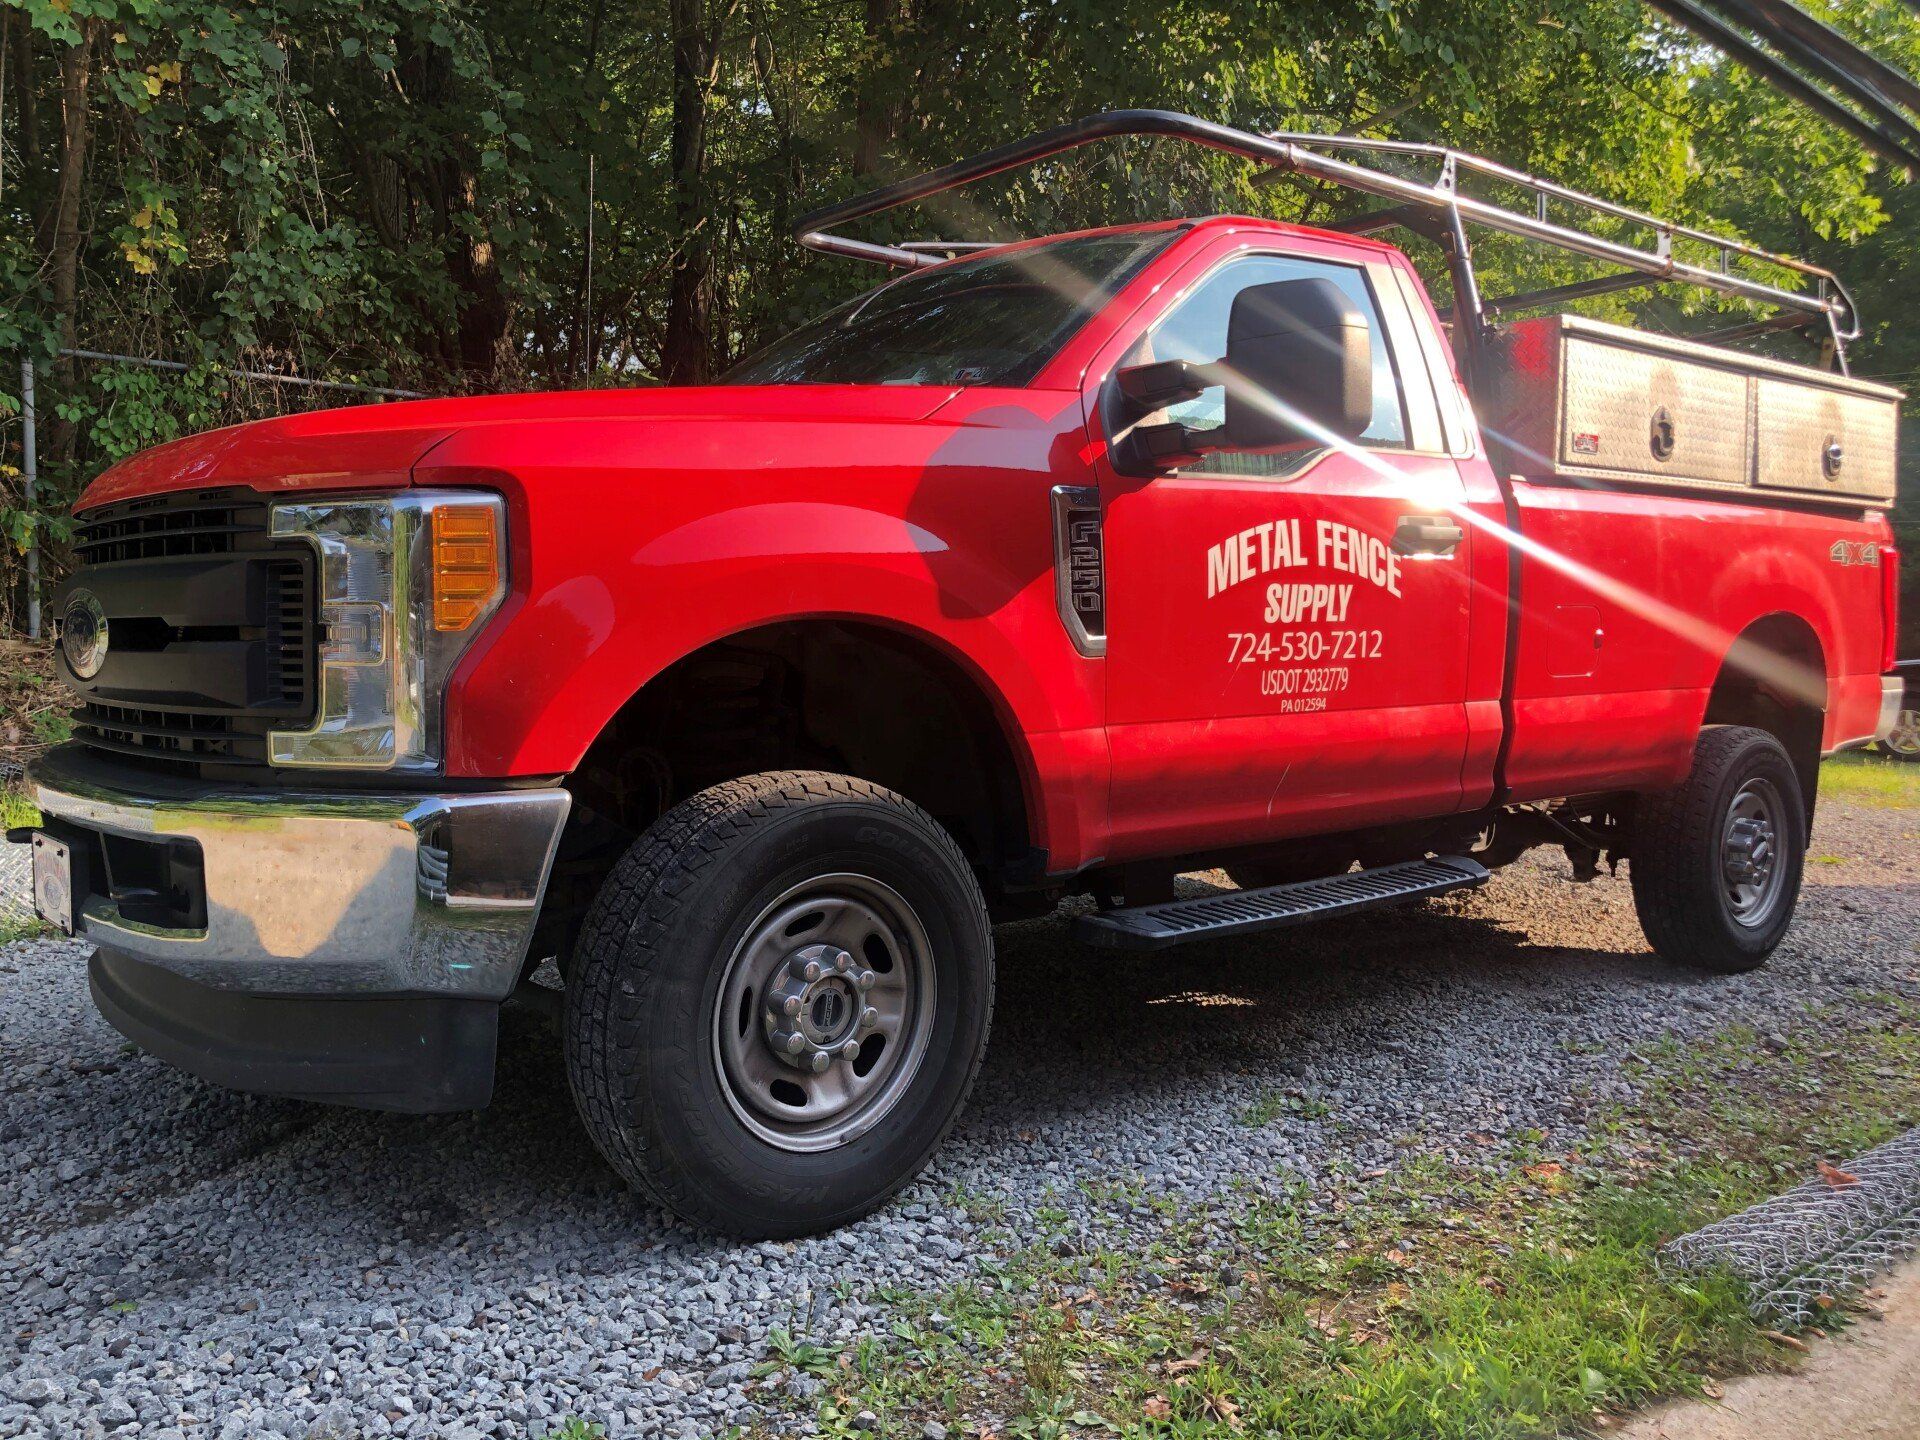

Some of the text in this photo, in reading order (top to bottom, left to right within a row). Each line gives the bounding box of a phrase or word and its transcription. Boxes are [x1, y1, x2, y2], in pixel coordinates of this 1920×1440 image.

[1208, 519, 1402, 599] METAL FENCE
[1264, 583, 1353, 623] SUPPLY
[1228, 630, 1383, 663] 724-530-7212
[1261, 667, 1348, 695] USDOT 2932779
[1281, 698, 1326, 713] PA 012594
